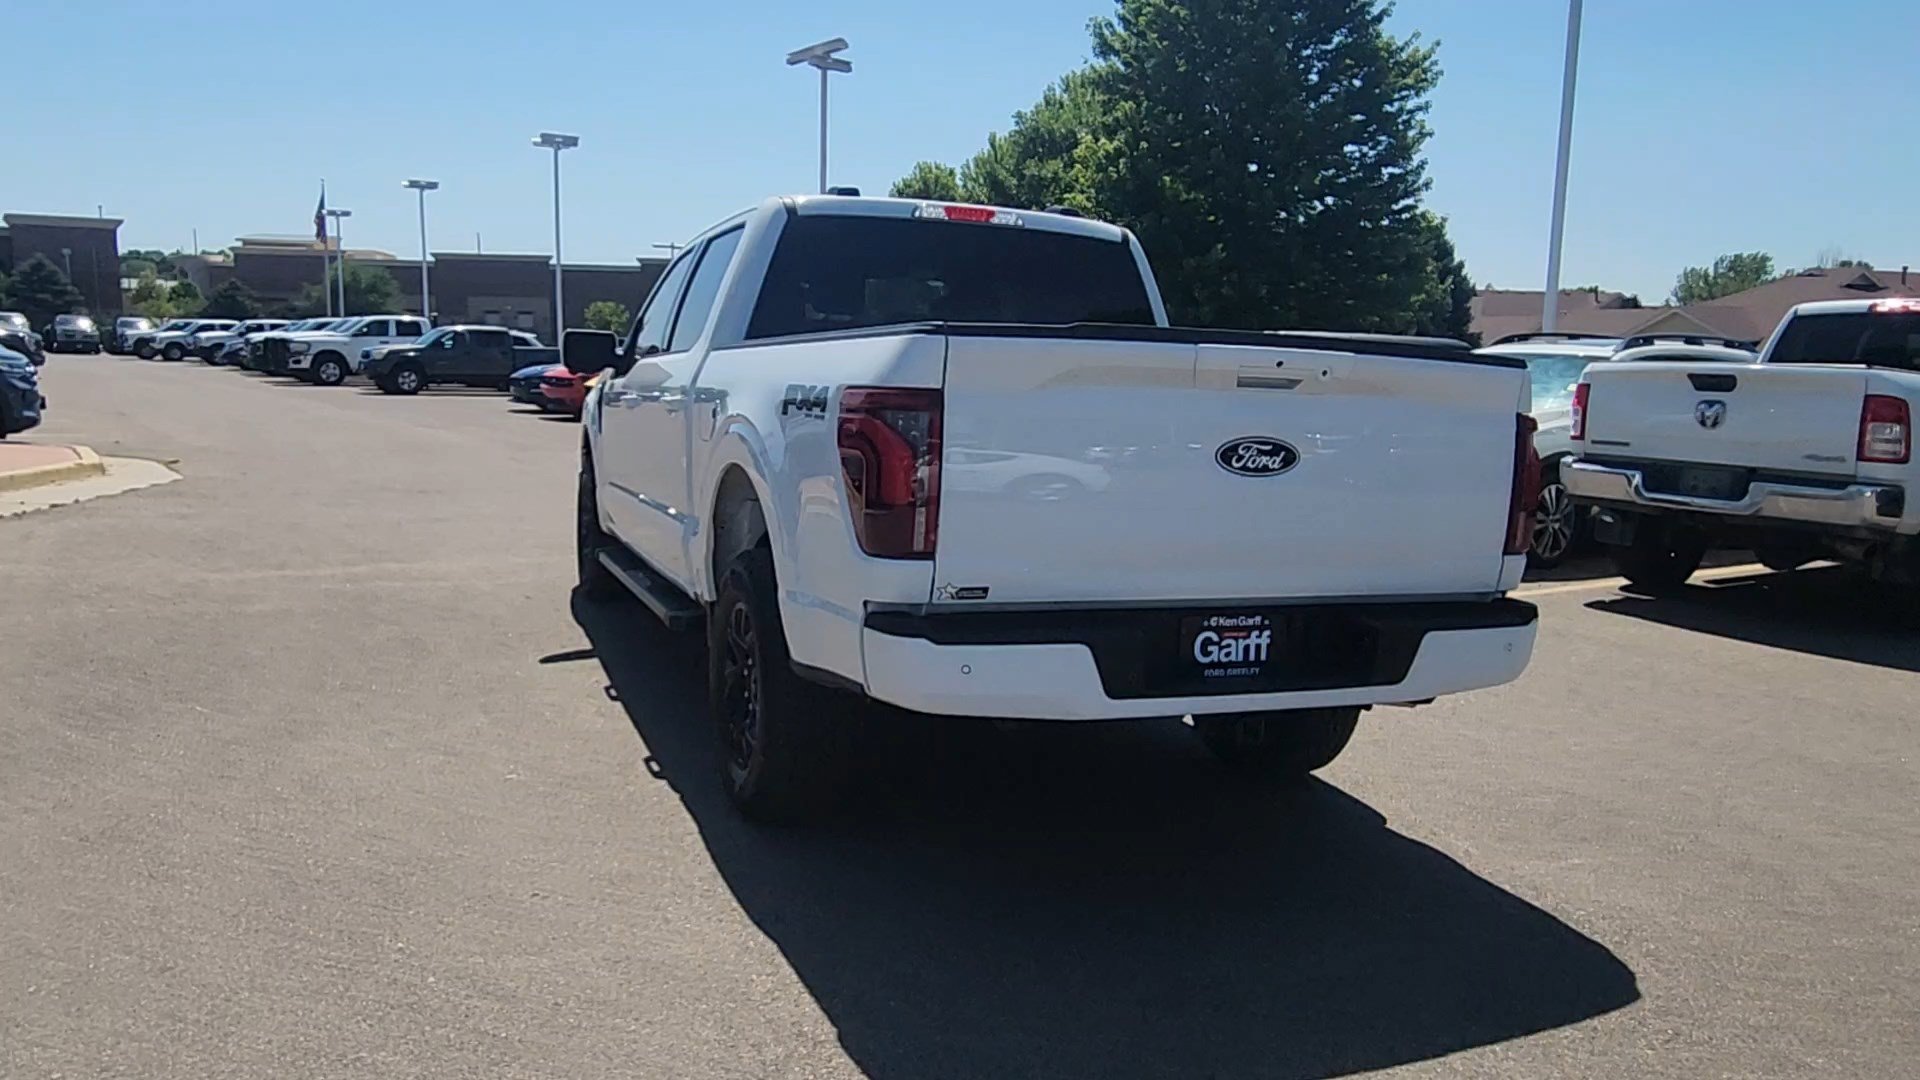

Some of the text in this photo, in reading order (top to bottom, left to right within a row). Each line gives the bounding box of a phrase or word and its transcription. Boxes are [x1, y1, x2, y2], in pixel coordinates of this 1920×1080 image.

[781, 384, 830, 416] FX4
[1231, 443, 1285, 469] Ford
[1218, 615, 1262, 627] Ken Garff
[1194, 630, 1271, 663] Garff
[1204, 668, 1225, 677] FORD
